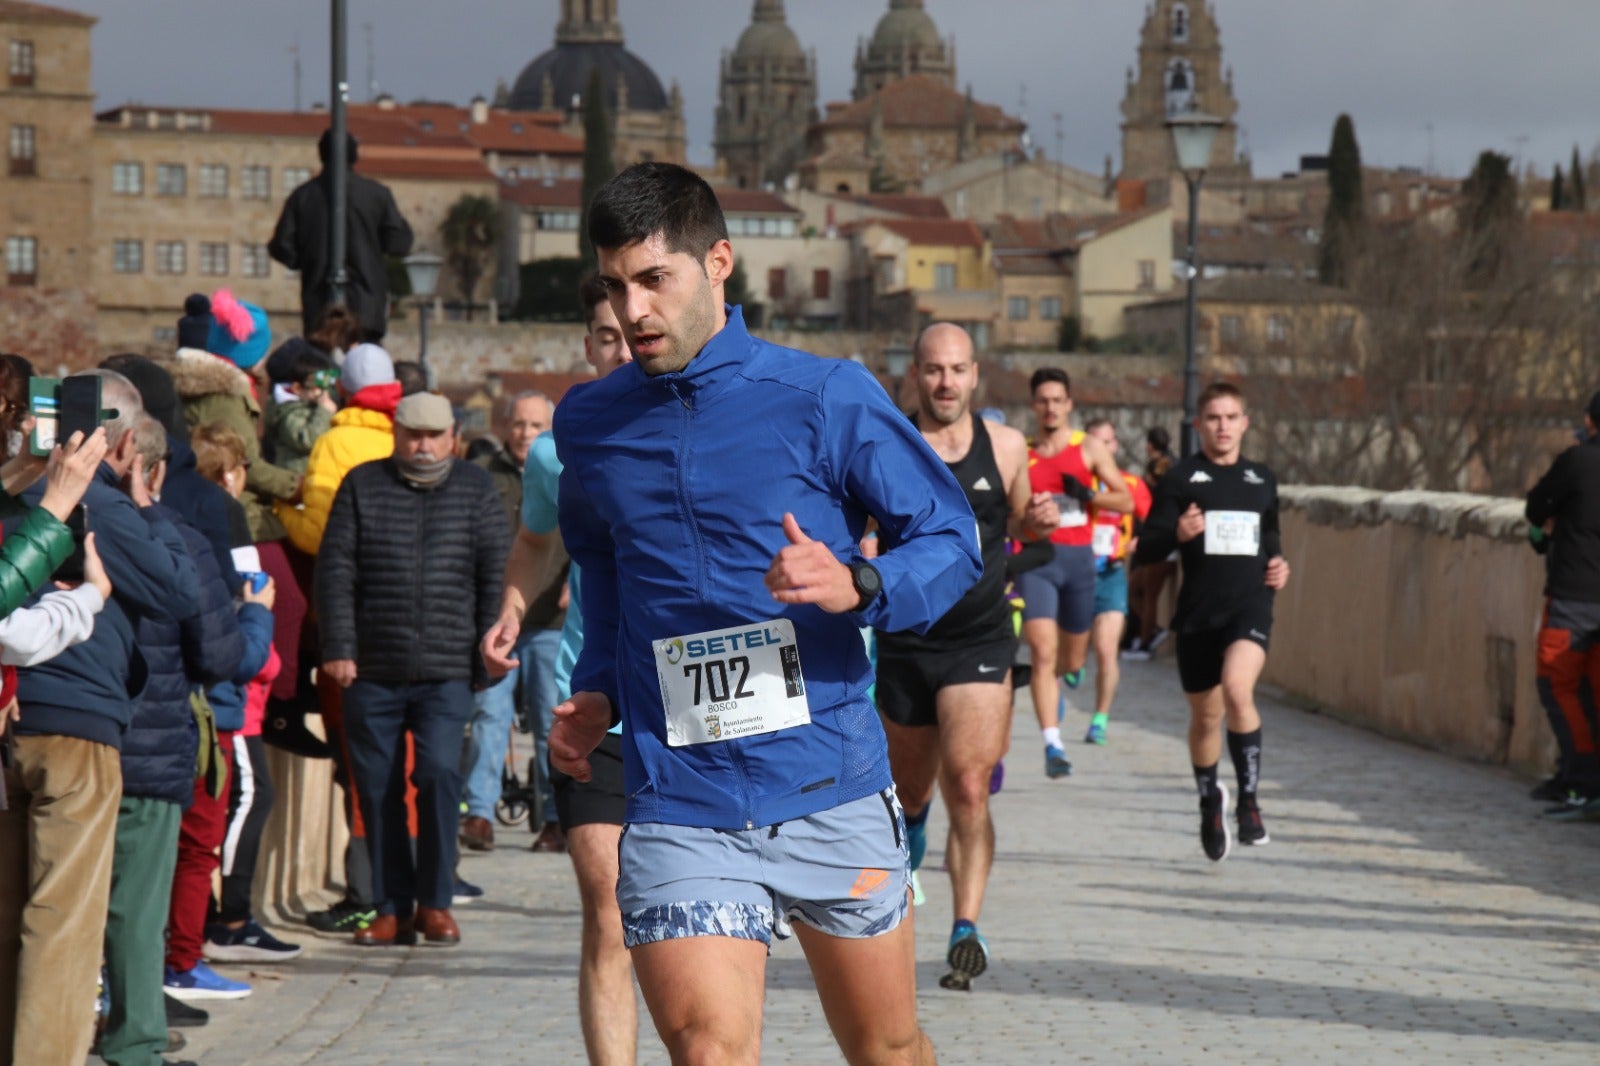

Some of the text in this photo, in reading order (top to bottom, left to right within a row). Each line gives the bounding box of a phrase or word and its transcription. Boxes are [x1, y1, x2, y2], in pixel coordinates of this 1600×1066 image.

[686, 628, 781, 658] SETEL
[683, 655, 755, 706] 702
[707, 701, 738, 714] BOSCO
[723, 715, 763, 728] Ayuntamiento
[732, 724, 765, 735] Salamanca
